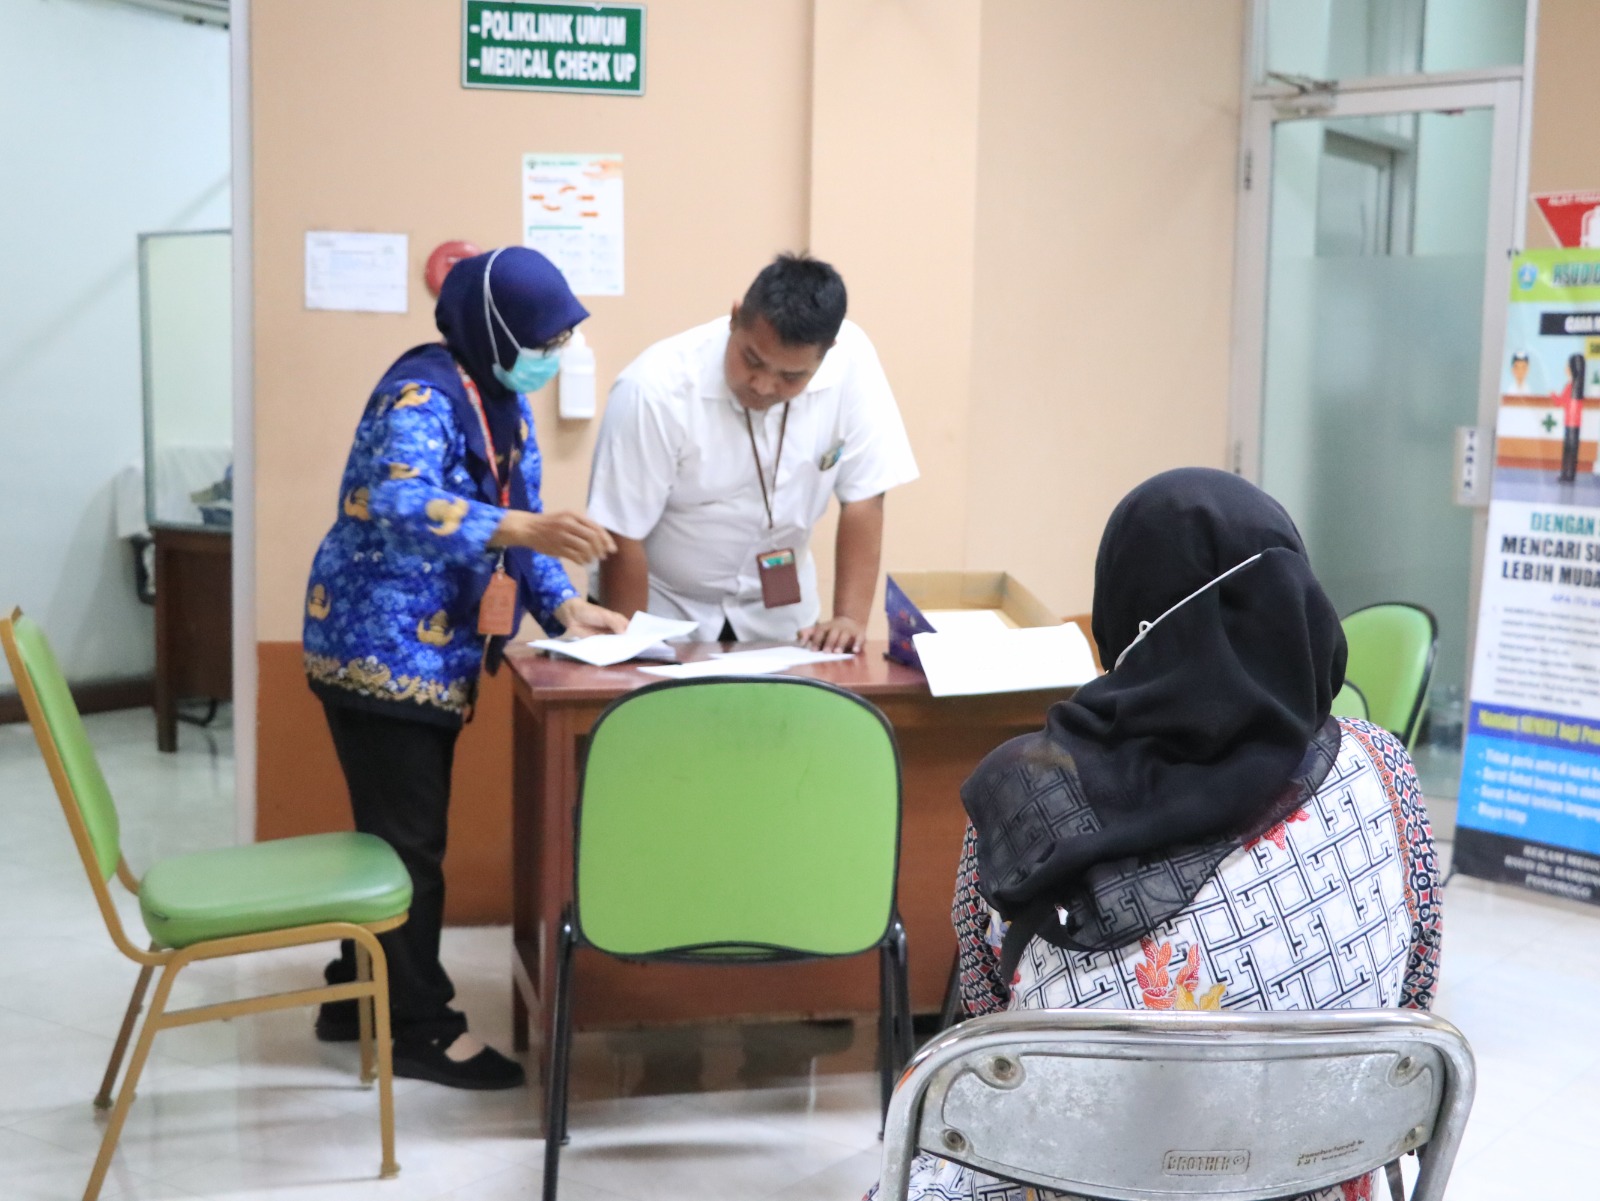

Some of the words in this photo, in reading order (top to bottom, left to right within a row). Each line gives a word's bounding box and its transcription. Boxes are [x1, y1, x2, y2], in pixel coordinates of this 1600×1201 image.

[576, 14, 626, 46] UMUM
[554, 49, 611, 81] CHECK
[613, 53, 637, 82] UP
[1530, 512, 1595, 535] DENGAN
[1501, 535, 1581, 560] MENCARI
[1502, 560, 1554, 583] LEBIH
[1167, 1155, 1231, 1170] BROTHER
